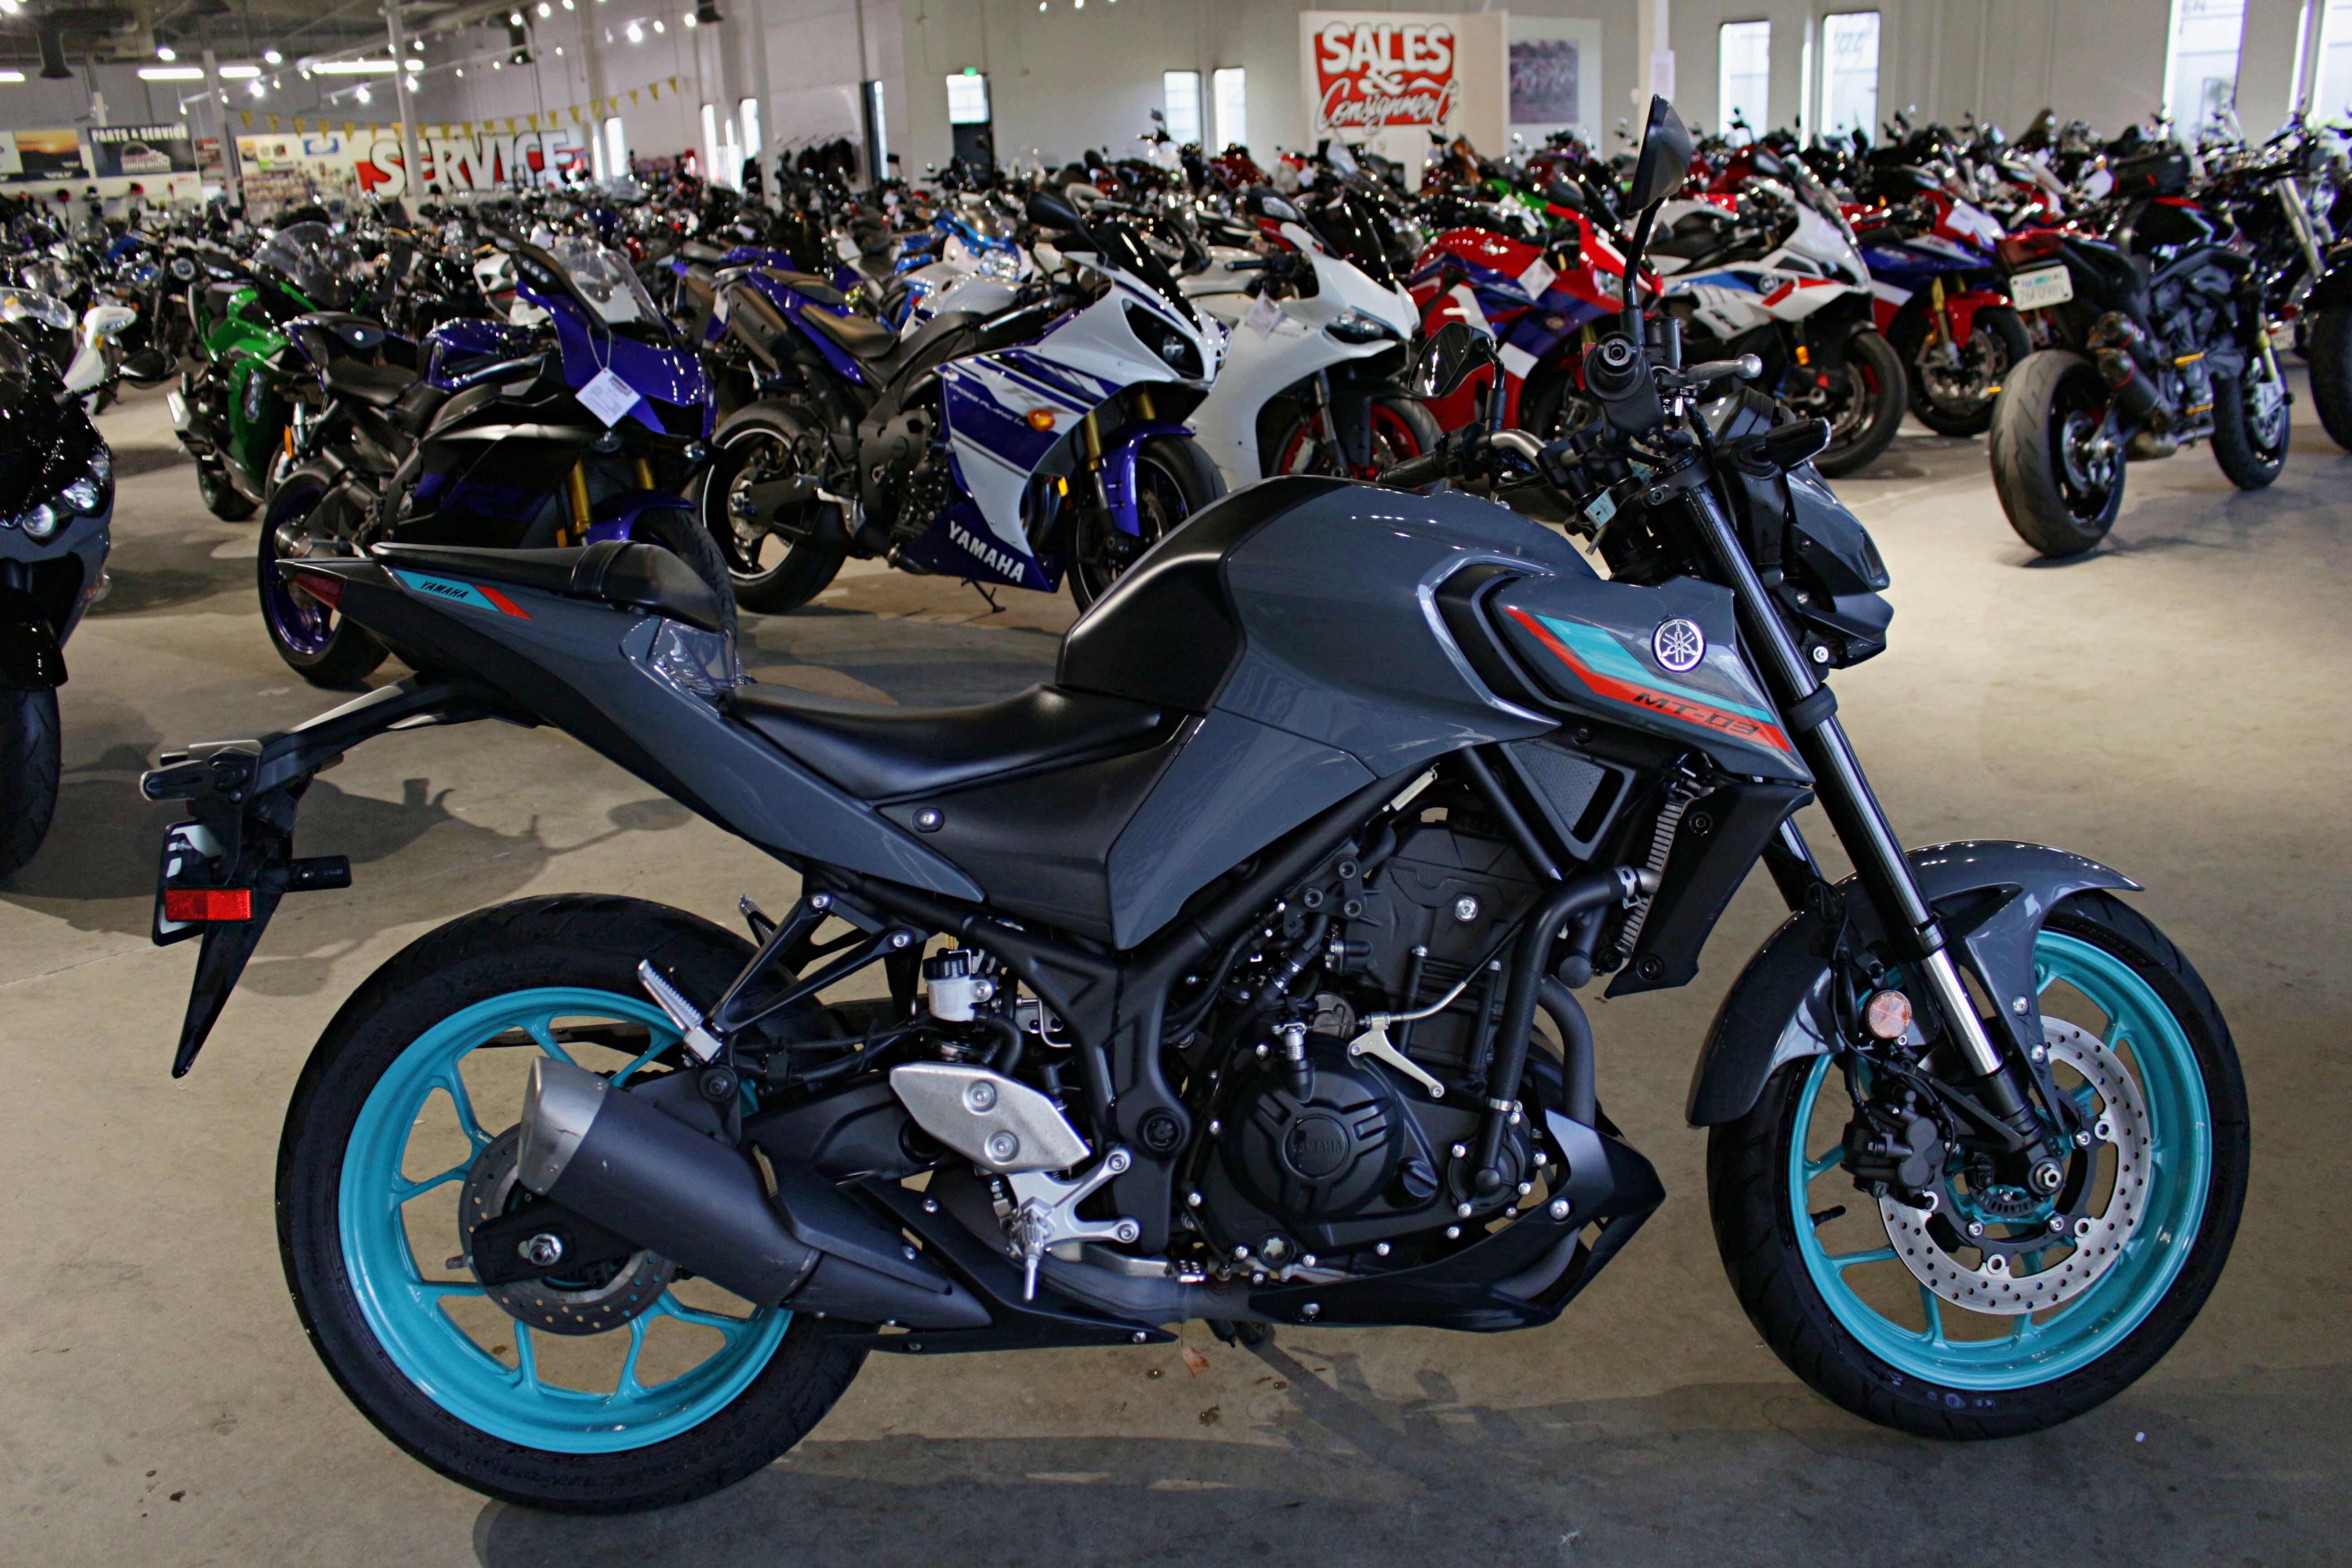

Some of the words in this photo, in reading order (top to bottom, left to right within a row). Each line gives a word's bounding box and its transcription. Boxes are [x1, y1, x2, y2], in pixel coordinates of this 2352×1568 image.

[1320, 21, 1452, 74] SALES
[1357, 68, 1406, 96] &
[1315, 77, 1460, 136] Consignment
[91, 128, 129, 143] PARTS
[139, 124, 188, 142] SERVICE
[369, 129, 569, 196] SERVICE
[949, 520, 1025, 583] YAMAHA
[420, 581, 469, 598] YAMAHA
[1633, 692, 1759, 736] MT-03
